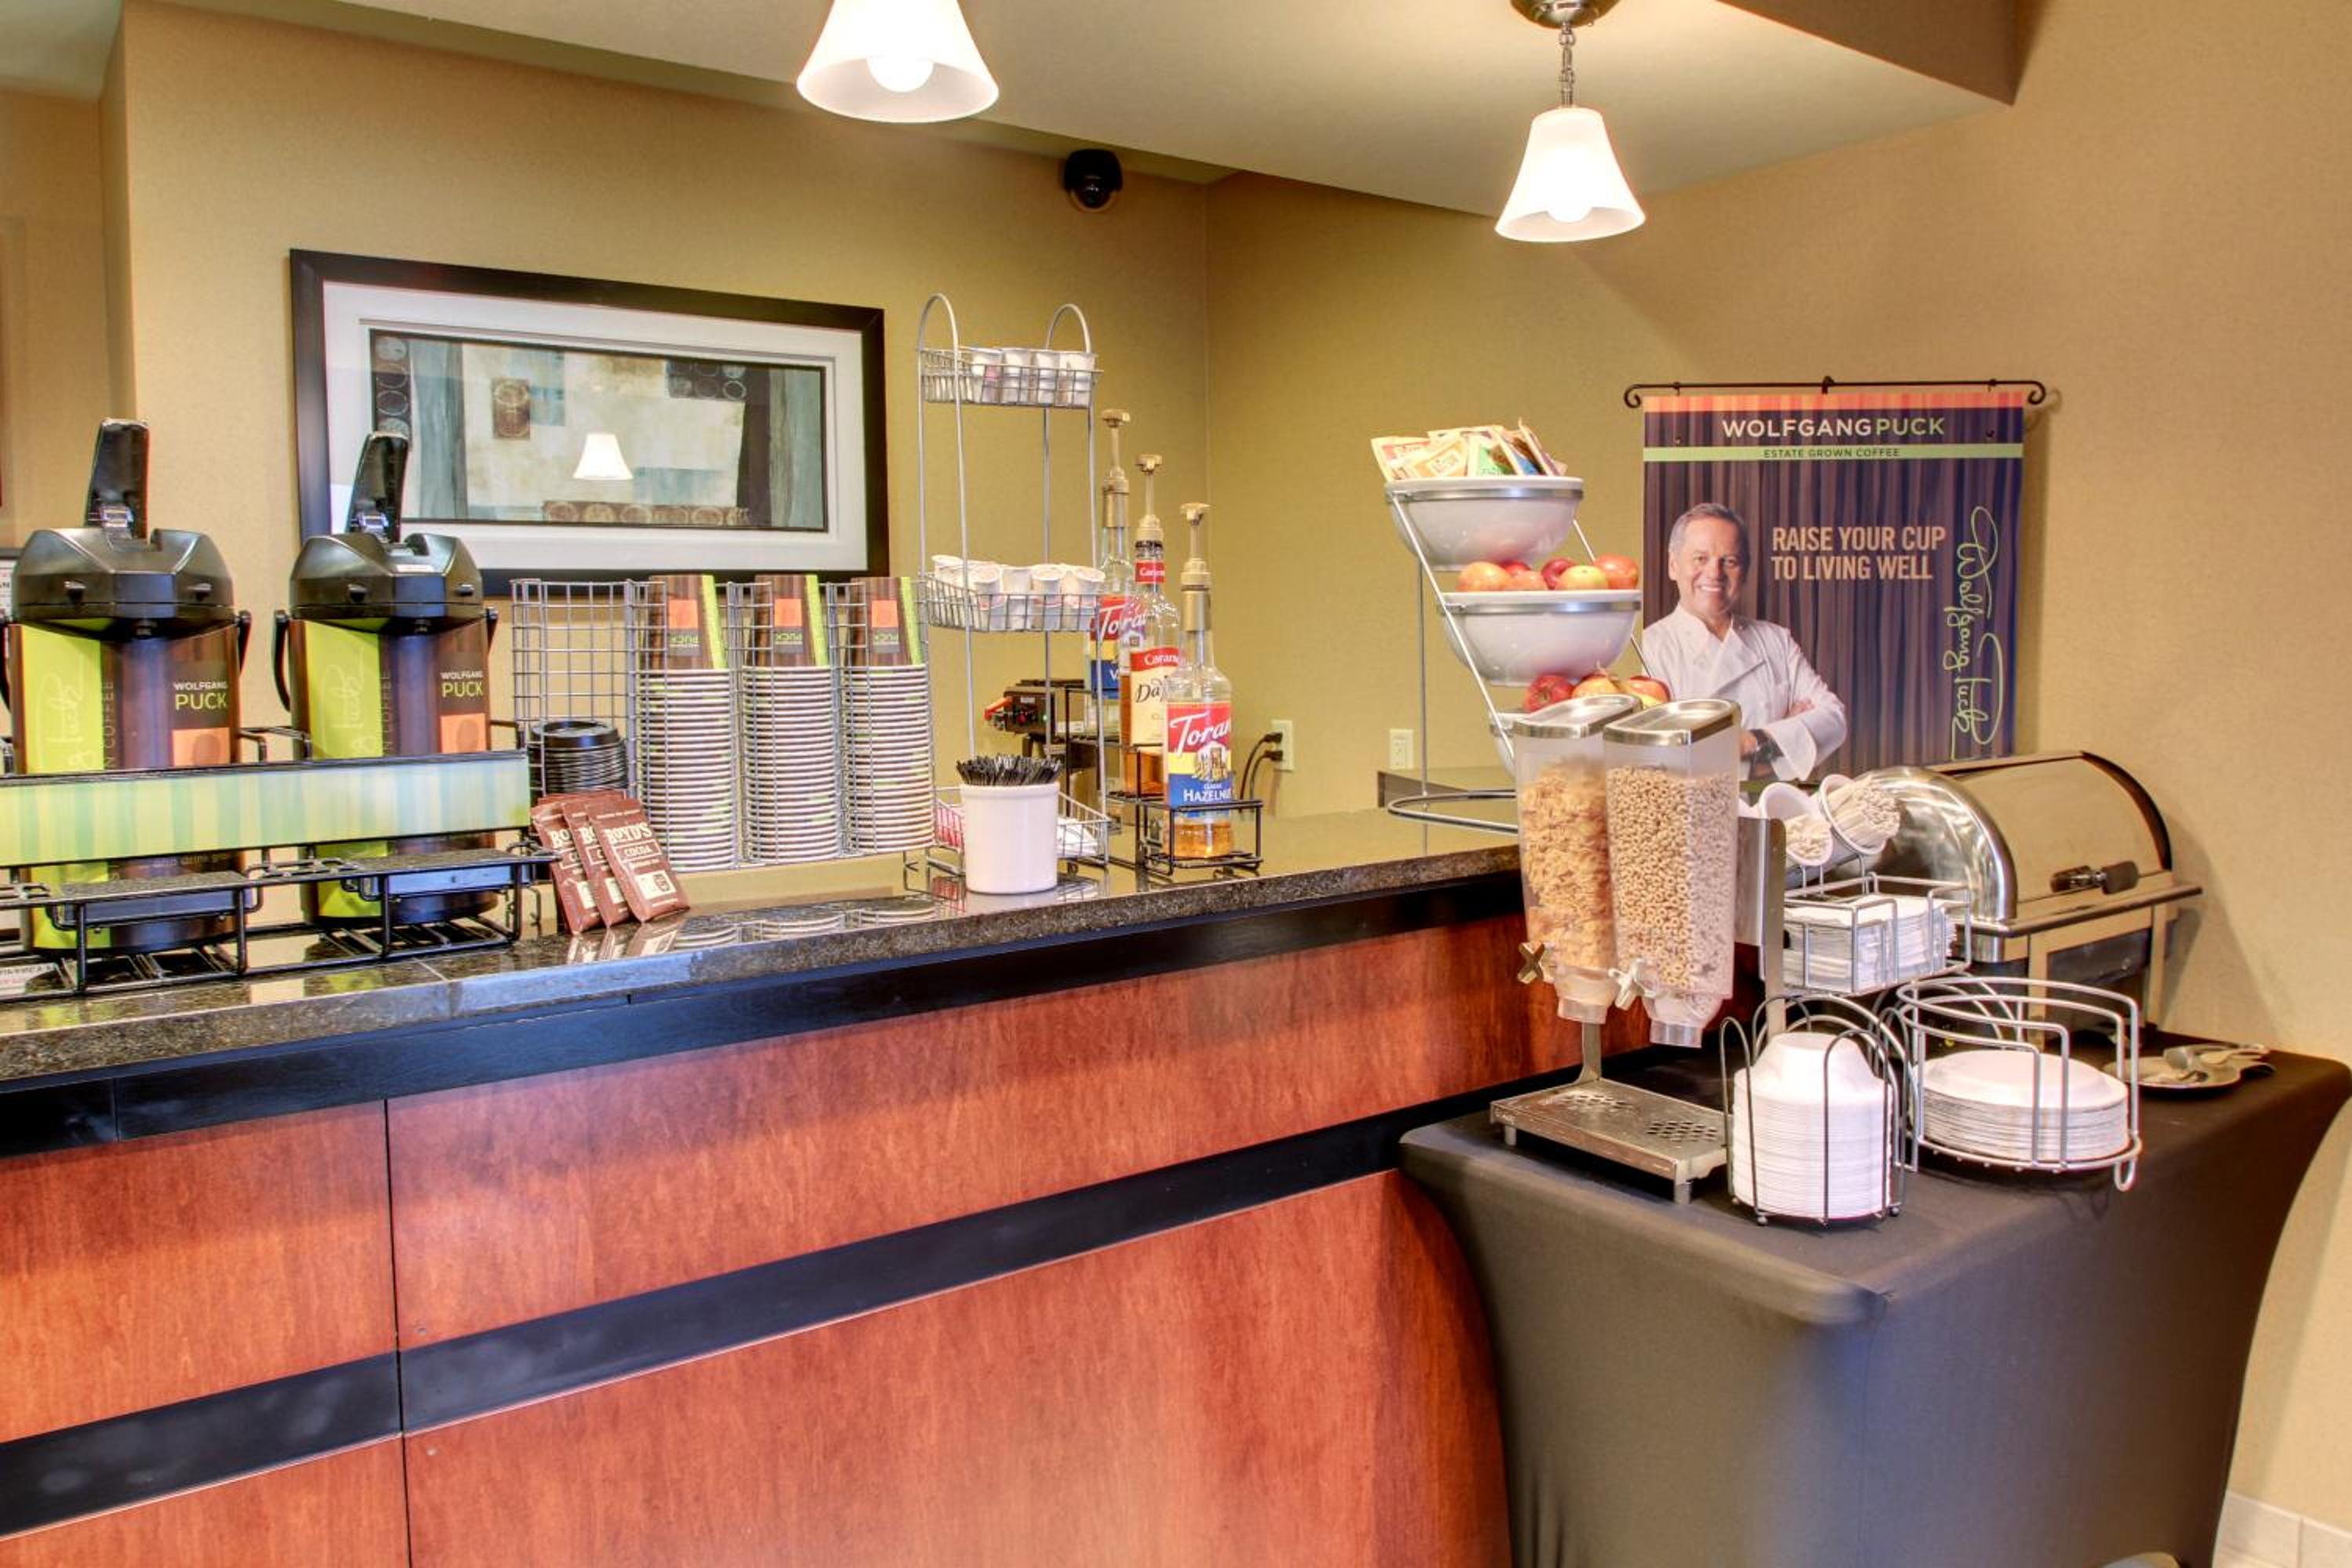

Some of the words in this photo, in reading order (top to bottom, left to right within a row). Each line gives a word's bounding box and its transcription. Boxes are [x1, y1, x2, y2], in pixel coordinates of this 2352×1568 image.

[1722, 418, 1871, 437] WOLFGANG
[1875, 417, 1945, 436] PUCK
[1764, 449, 1803, 458] ESTATE
[1809, 448, 1853, 458] GROWN
[1856, 448, 1900, 457] COFFEE
[1772, 527, 1834, 551] RAISE
[1838, 526, 1895, 550] YOUR
[1901, 526, 1947, 550] CUP
[1770, 557, 1797, 580] TO
[1803, 556, 1871, 580] LIVING
[1877, 555, 1933, 579] WELL
[439, 670, 484, 681] WOLFGANG
[173, 680, 227, 691] WOLFGANG
[441, 681, 484, 699] PUCK
[174, 692, 227, 710] PUCK
